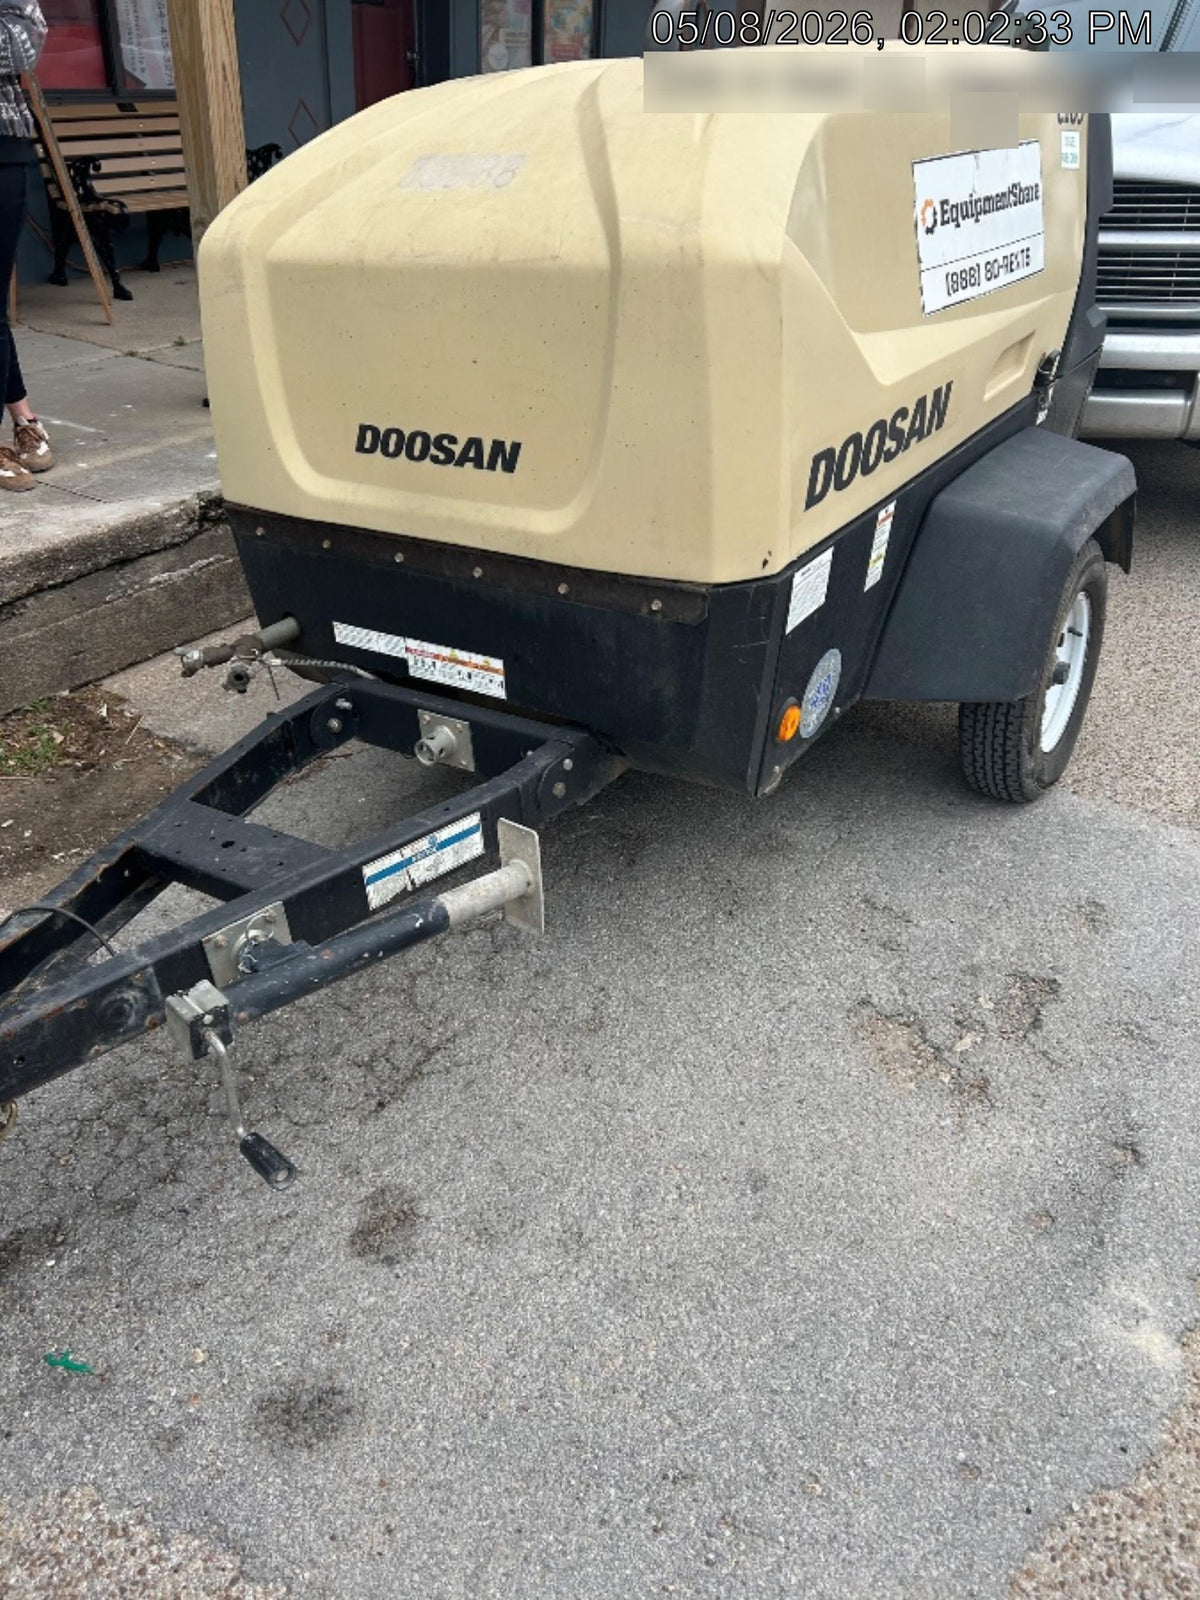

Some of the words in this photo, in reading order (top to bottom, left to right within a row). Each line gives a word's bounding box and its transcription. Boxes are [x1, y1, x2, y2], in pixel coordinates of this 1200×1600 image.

[939, 182, 1040, 228] EquipmentShare
[945, 263, 981, 296] (888)
[355, 423, 522, 473] DOOSAN
[804, 380, 954, 512] DOOSAN
